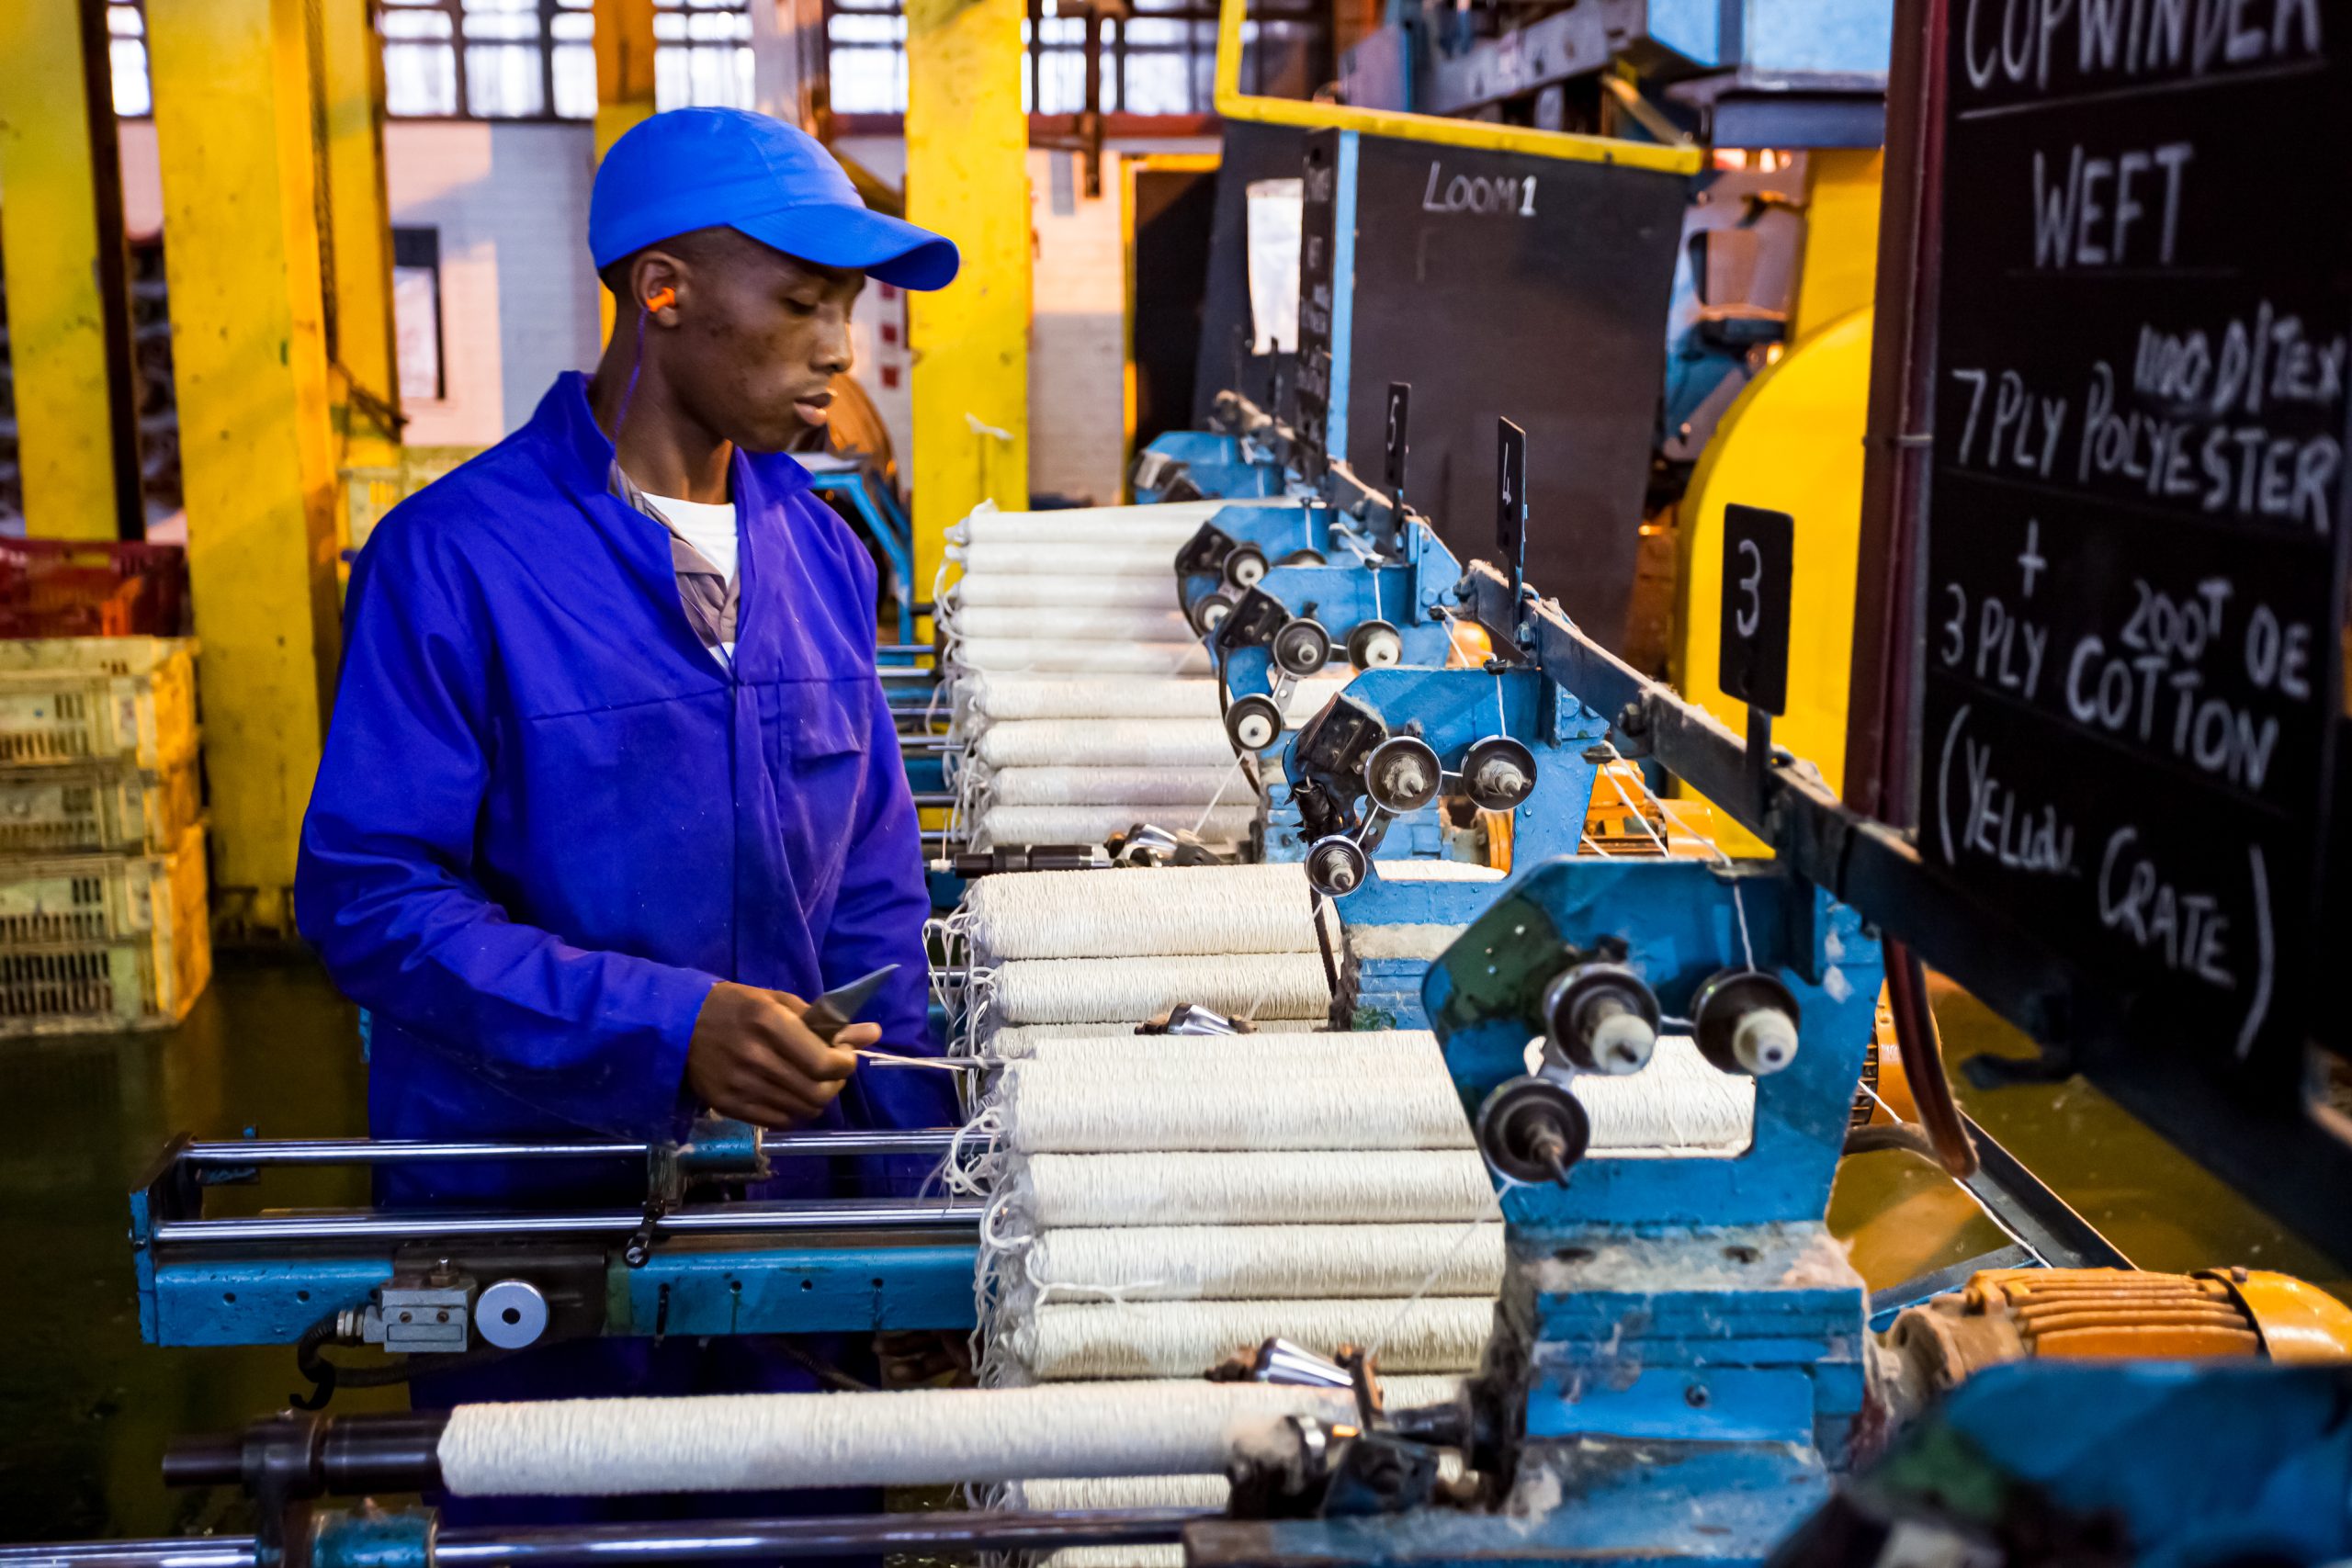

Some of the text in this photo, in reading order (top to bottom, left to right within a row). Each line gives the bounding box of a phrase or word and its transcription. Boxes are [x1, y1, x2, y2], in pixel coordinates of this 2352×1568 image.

[2033, 142, 2194, 268] WEFT
[1387, 395, 1399, 452] 5
[2078, 360, 2342, 535] POLYESTER
[1736, 538, 1761, 637] 3
[2067, 636, 2279, 790] COTTON
